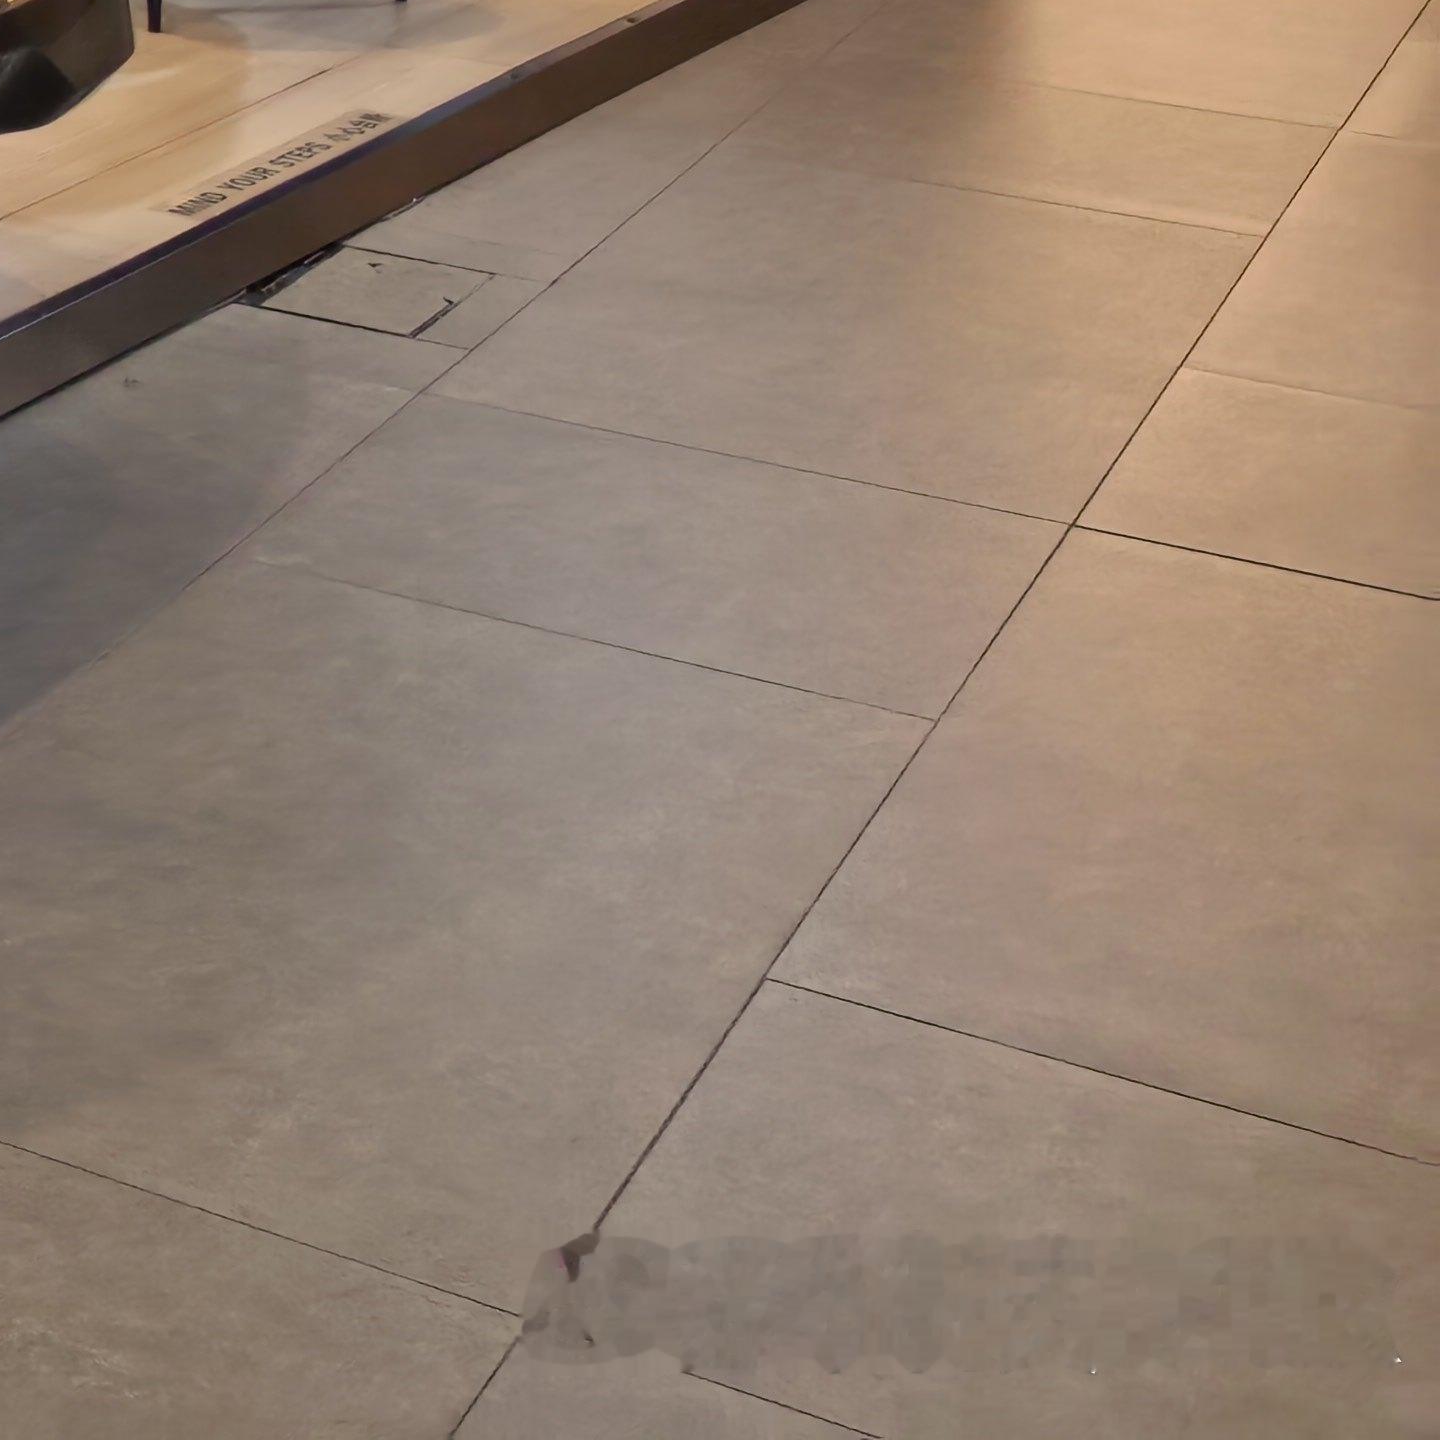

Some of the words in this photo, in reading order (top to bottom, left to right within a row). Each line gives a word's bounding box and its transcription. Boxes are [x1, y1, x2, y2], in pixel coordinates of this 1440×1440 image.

[167, 188, 228, 217] MIND
[220, 166, 281, 192] YOUR
[268, 140, 332, 169] STEPS
